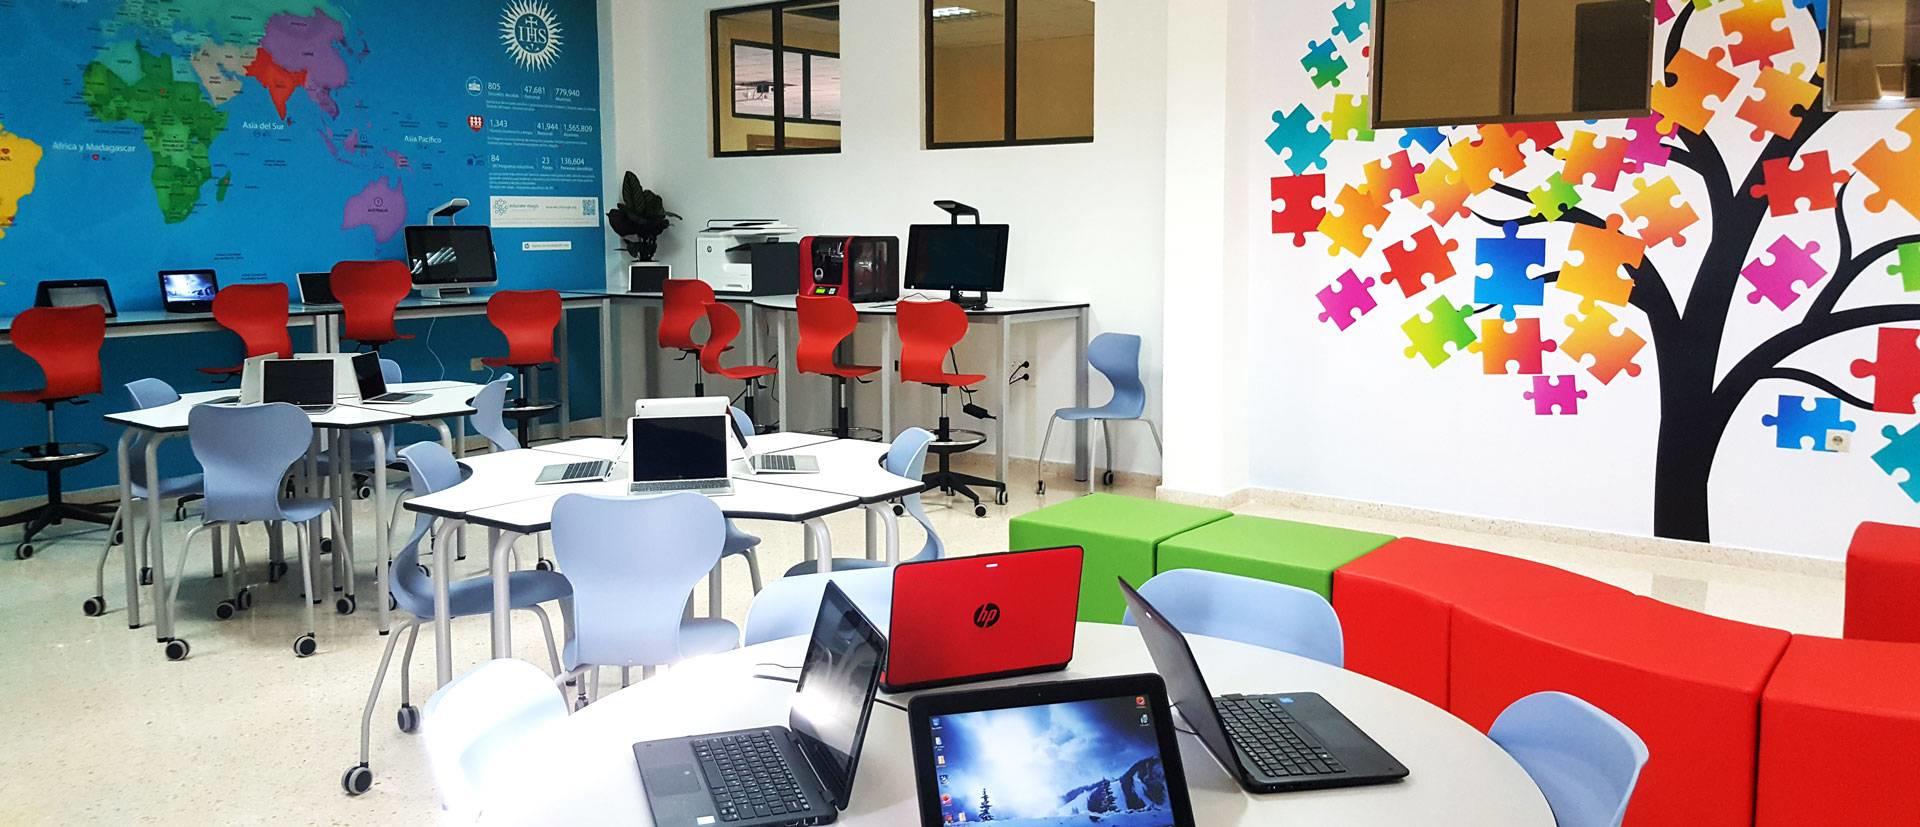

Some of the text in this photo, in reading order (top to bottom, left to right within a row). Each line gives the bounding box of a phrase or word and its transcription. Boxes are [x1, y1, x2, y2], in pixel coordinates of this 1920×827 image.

[518, 25, 547, 44] IHS
[488, 82, 501, 91] 805
[242, 120, 285, 130] Asia del Sur
[404, 135, 417, 143] Asia
[85, 143, 136, 153] Madagascar
[490, 154, 500, 162] 84
[541, 156, 550, 164] 23
[976, 603, 999, 628] hp
